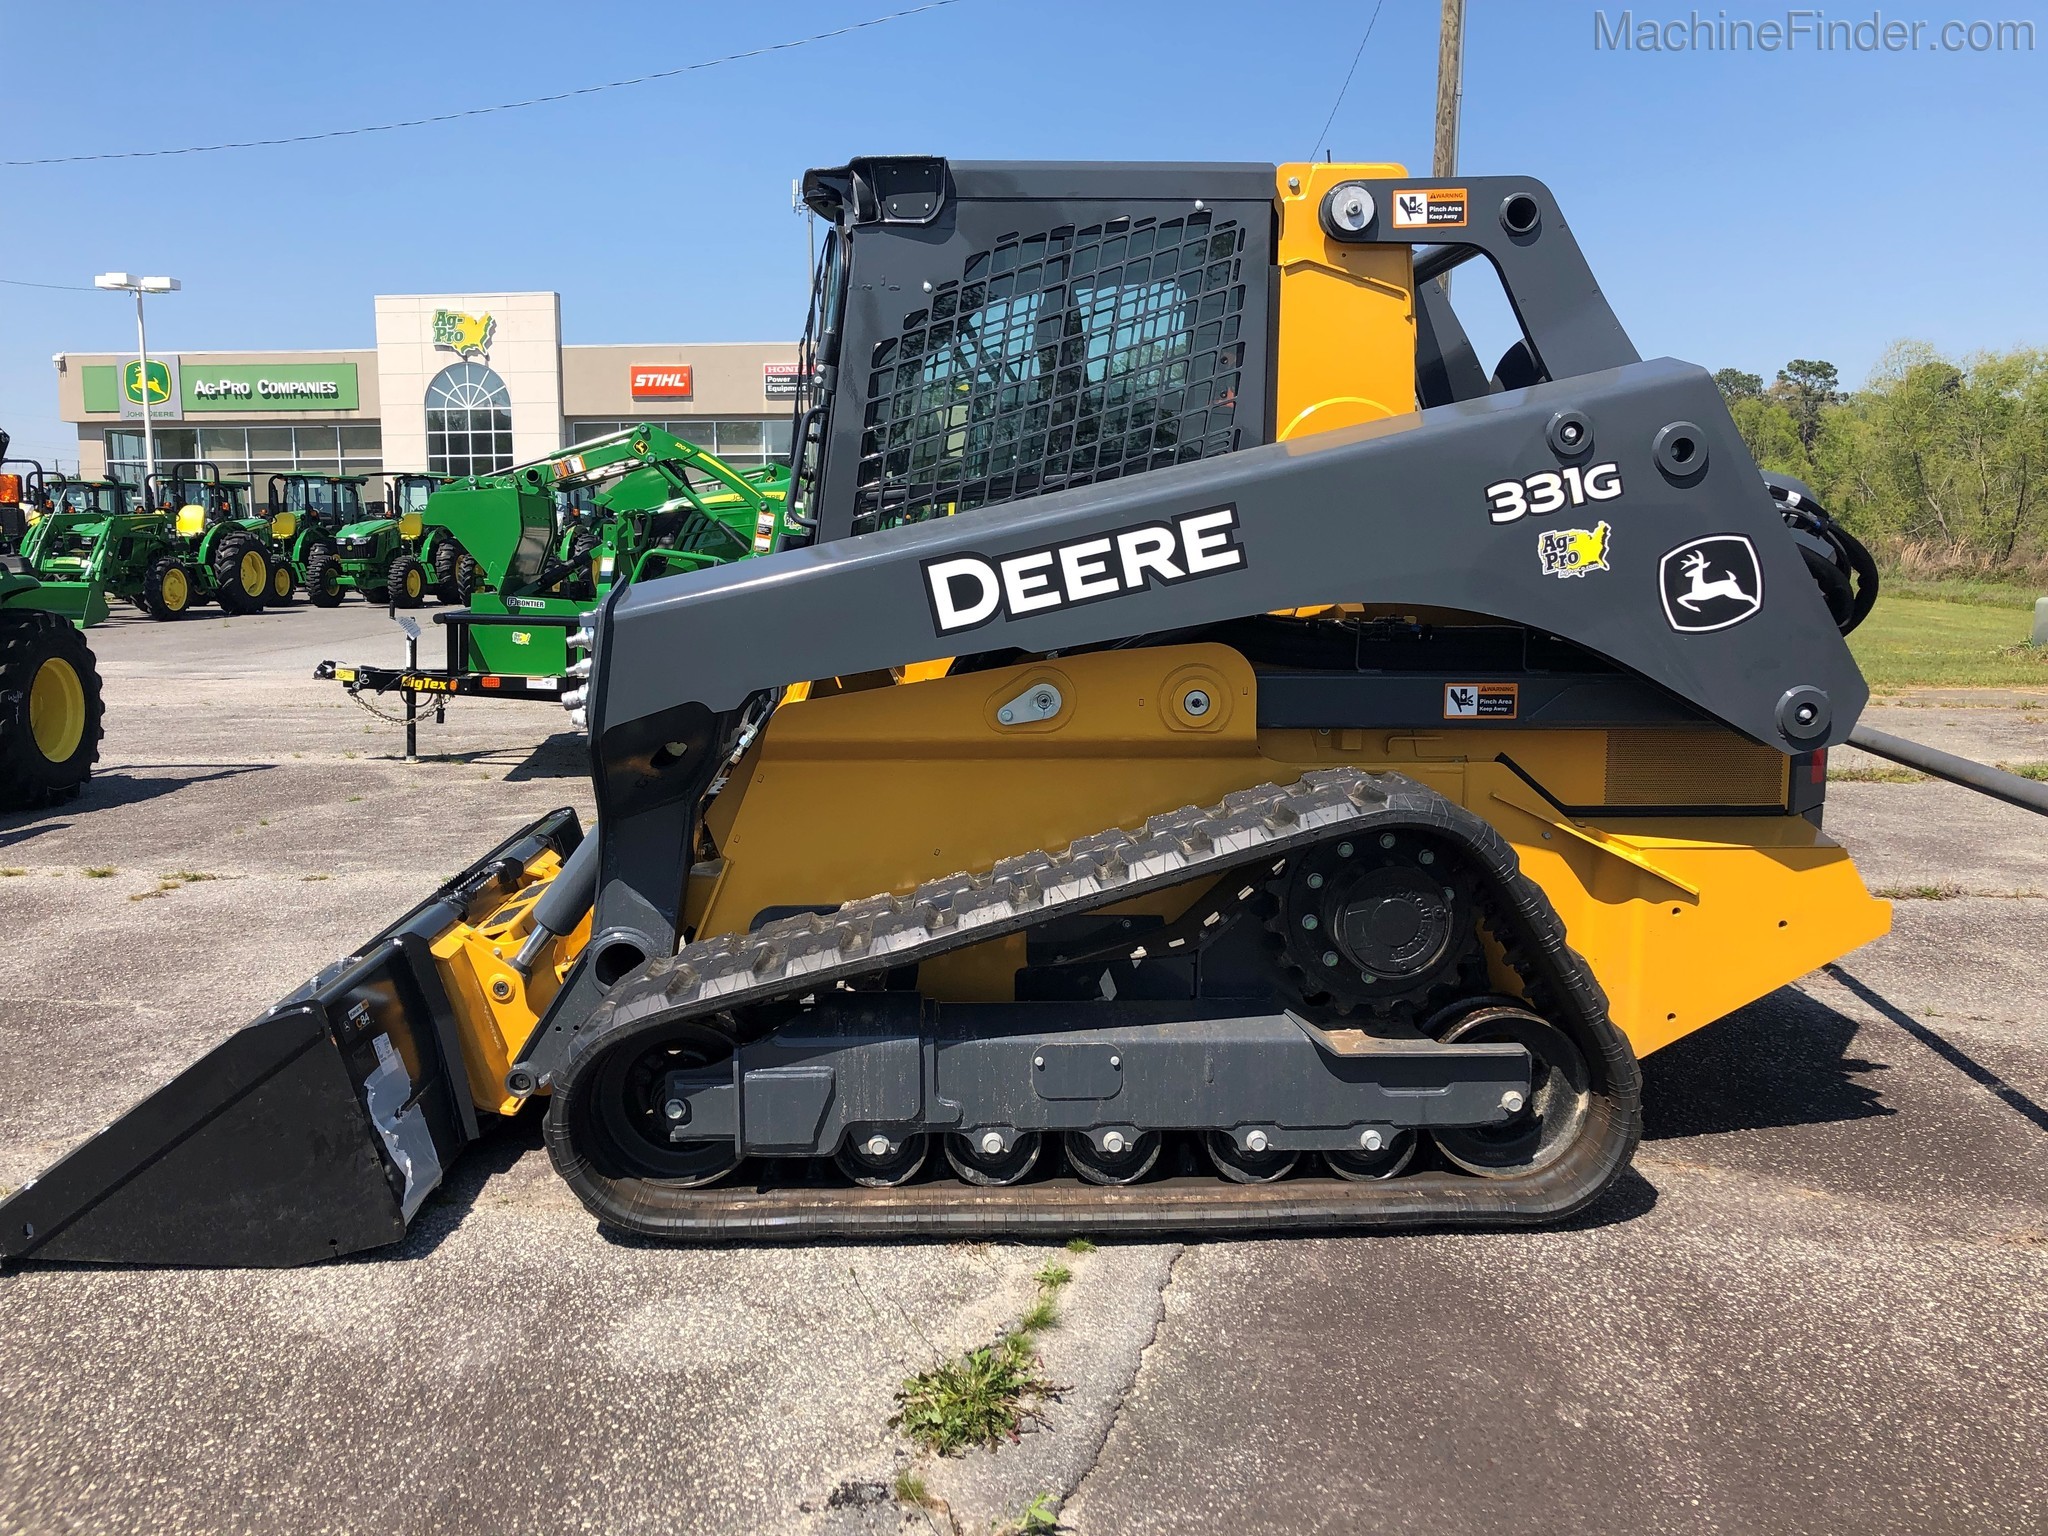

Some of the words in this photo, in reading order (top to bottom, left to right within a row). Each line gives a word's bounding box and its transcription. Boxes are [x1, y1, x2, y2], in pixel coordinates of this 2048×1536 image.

[1429, 205, 1447, 213] Pinch
[434, 310, 464, 330] Ag-
[434, 326, 465, 343] Pro
[634, 373, 686, 387] STIHL
[1485, 462, 1623, 524] 331G
[1542, 534, 1576, 555] Ag-
[926, 509, 1242, 631] DEERE
[1545, 551, 1580, 572] Pro
